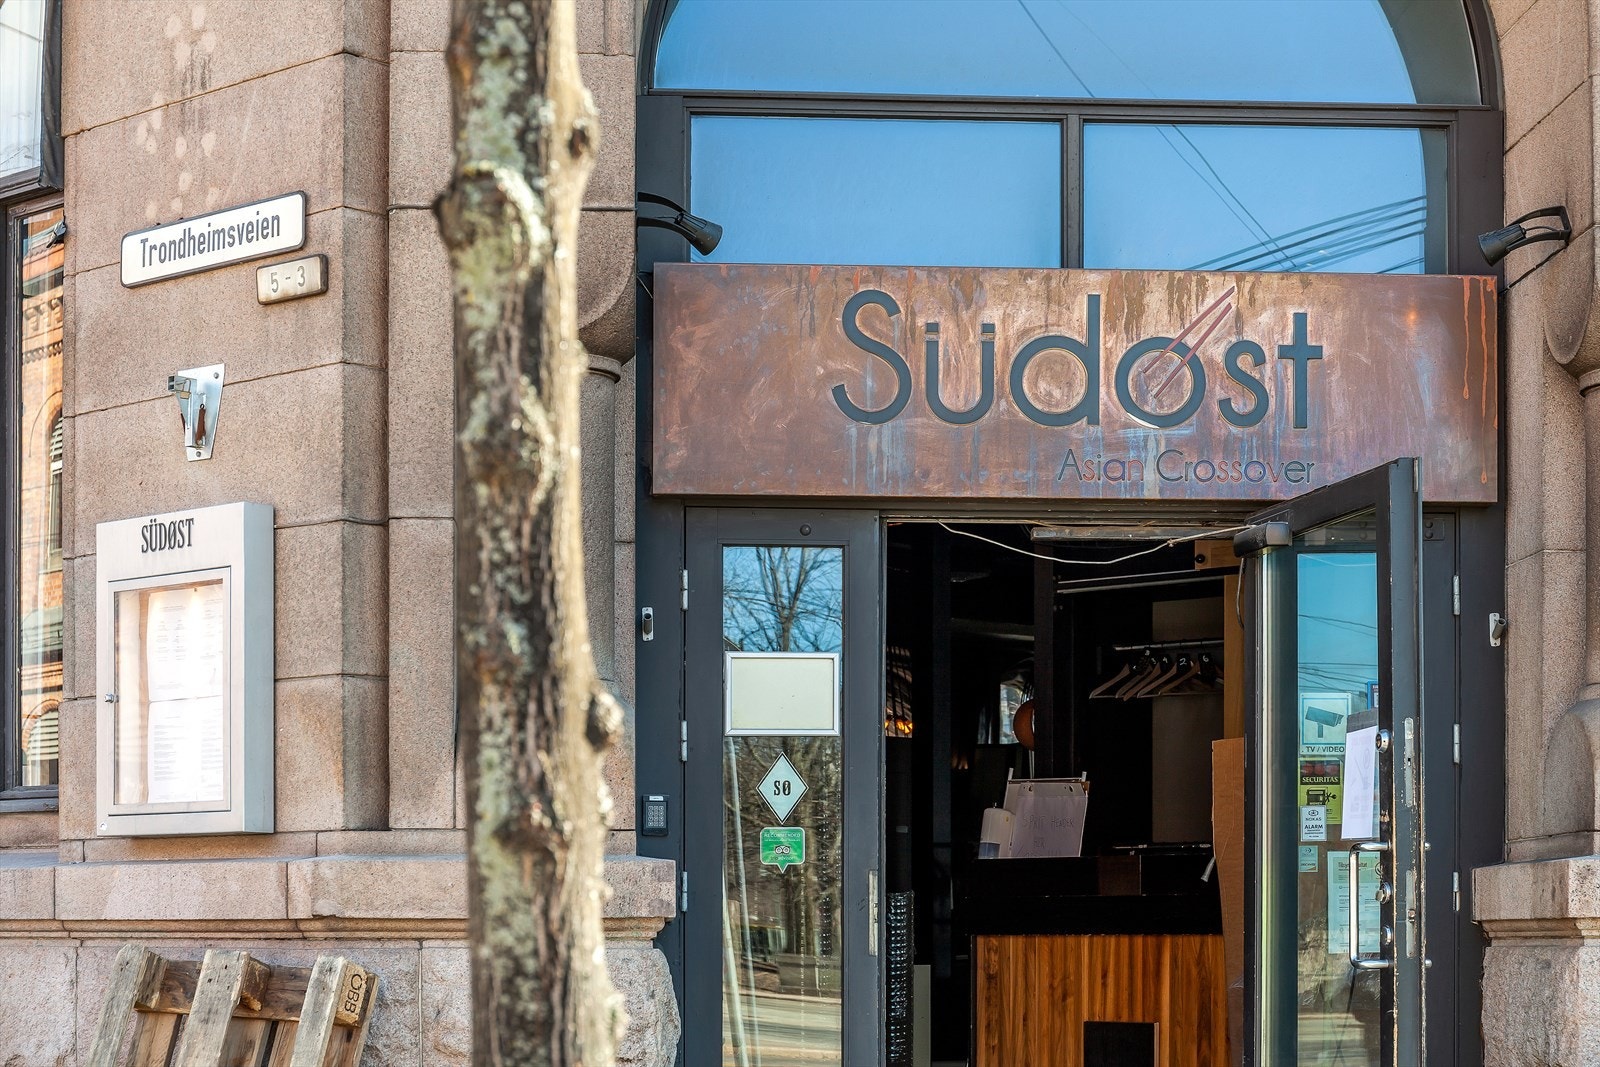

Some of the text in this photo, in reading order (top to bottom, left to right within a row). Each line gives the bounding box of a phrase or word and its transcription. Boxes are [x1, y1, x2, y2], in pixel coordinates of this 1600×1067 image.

[140, 211, 280, 267] Trondheimsveien
[1057, 448, 1316, 484] Asian Crossover
[141, 518, 195, 553] SÜDØST
